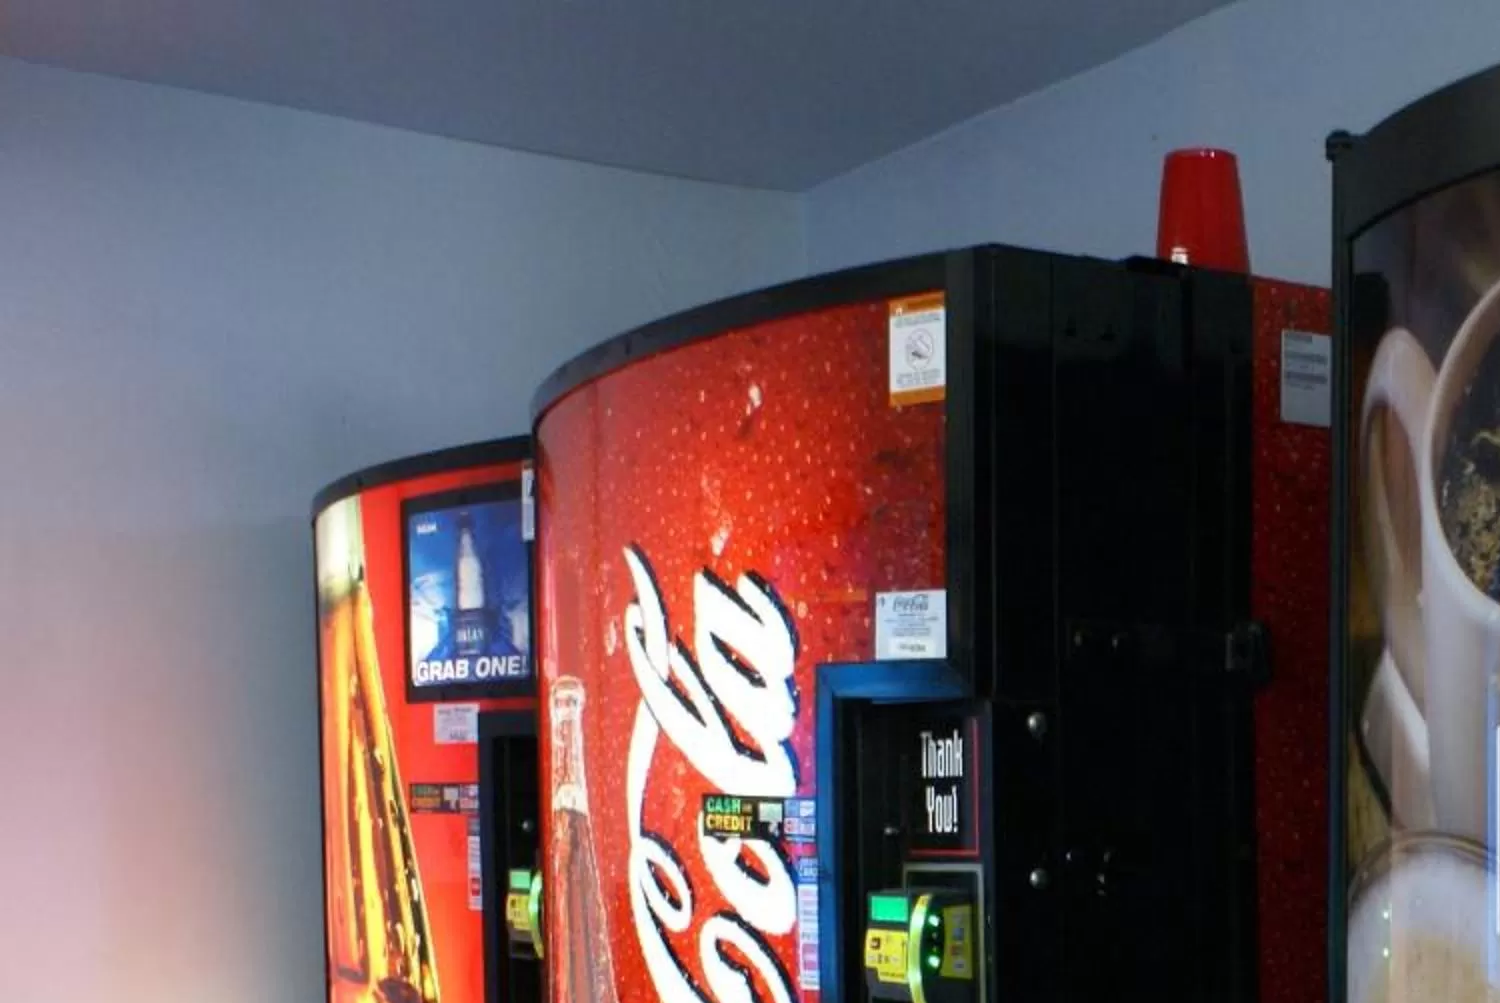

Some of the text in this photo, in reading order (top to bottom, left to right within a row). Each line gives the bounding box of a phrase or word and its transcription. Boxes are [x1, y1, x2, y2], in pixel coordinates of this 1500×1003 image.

[417, 655, 529, 682] GRAB ONE!
[920, 729, 963, 779] Thank
[705, 796, 742, 815] CASH
[925, 785, 960, 834] You!
[704, 812, 753, 832] CREDIT
